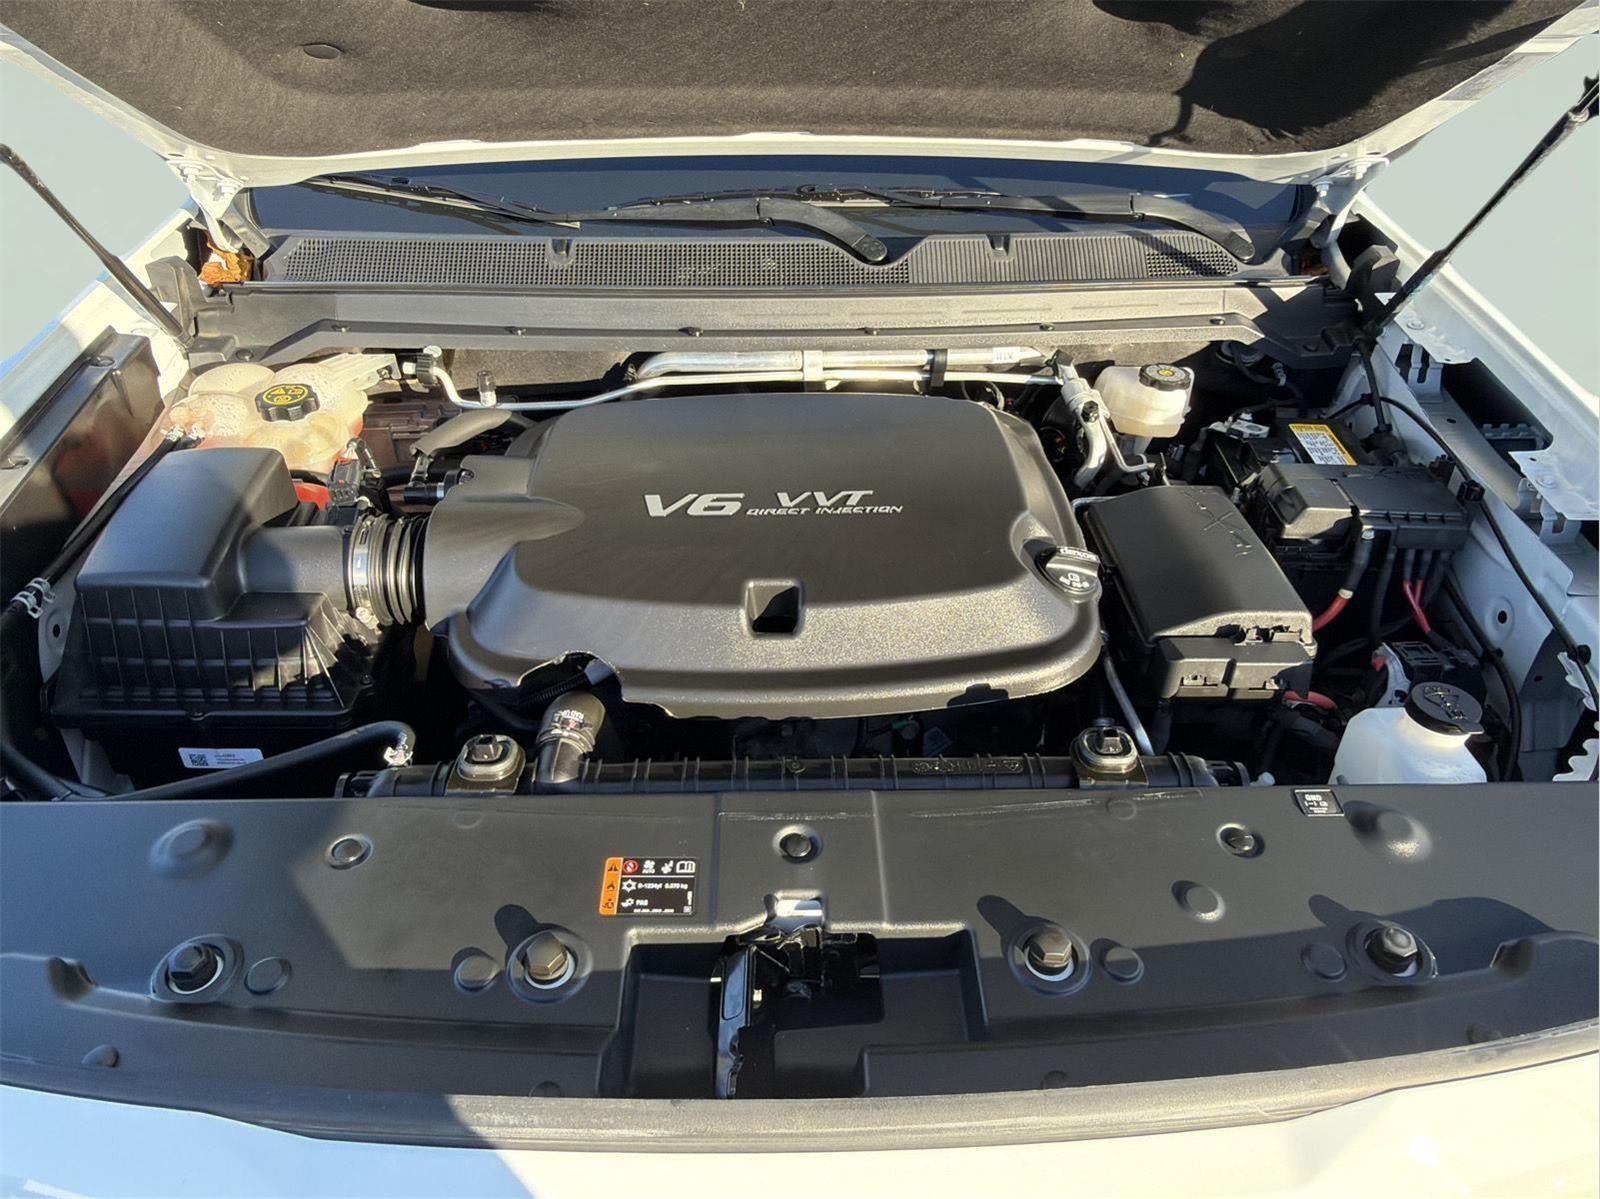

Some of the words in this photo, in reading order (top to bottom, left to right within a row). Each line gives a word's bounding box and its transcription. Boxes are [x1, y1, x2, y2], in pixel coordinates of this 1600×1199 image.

[644, 492, 745, 517] V6
[776, 489, 874, 508] VVT
[746, 506, 811, 517] DIRECT
[815, 504, 904, 516] INJECTION
